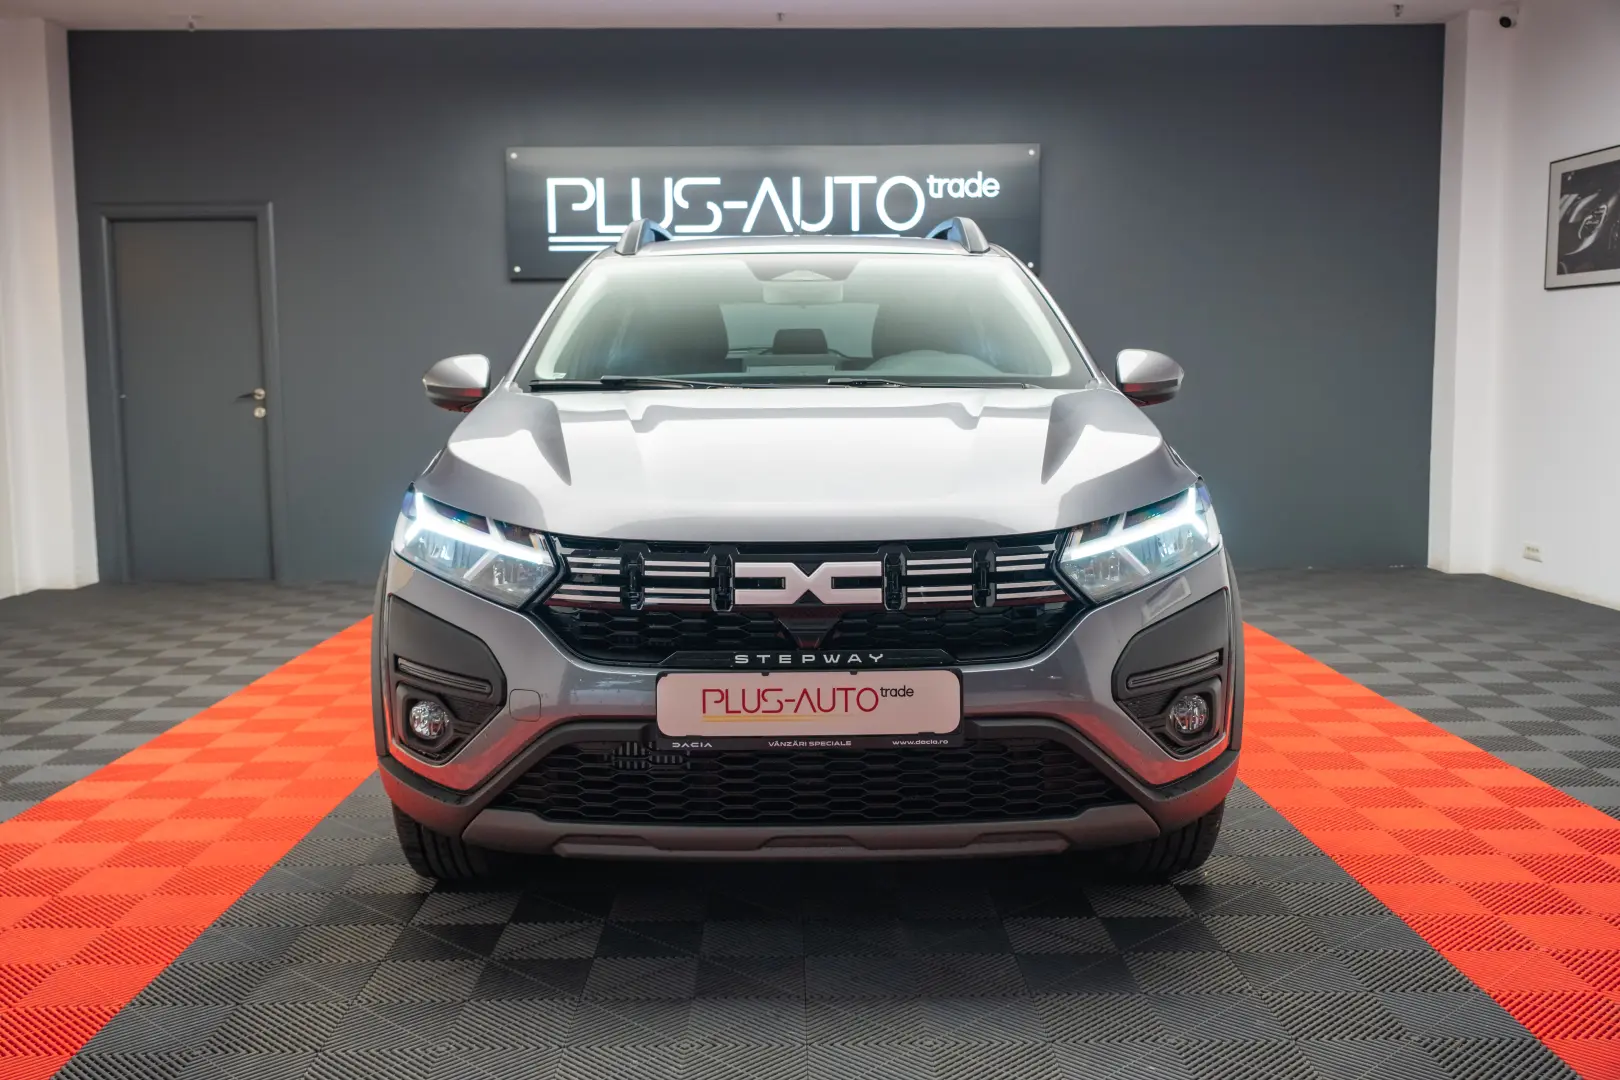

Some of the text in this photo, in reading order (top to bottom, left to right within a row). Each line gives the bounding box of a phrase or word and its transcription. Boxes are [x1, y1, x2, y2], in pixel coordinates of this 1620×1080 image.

[546, 171, 1001, 234] PLUS-AUTO trade
[734, 653, 884, 664] STEPWAY
[702, 685, 914, 714] PLUS-AUTO trade
